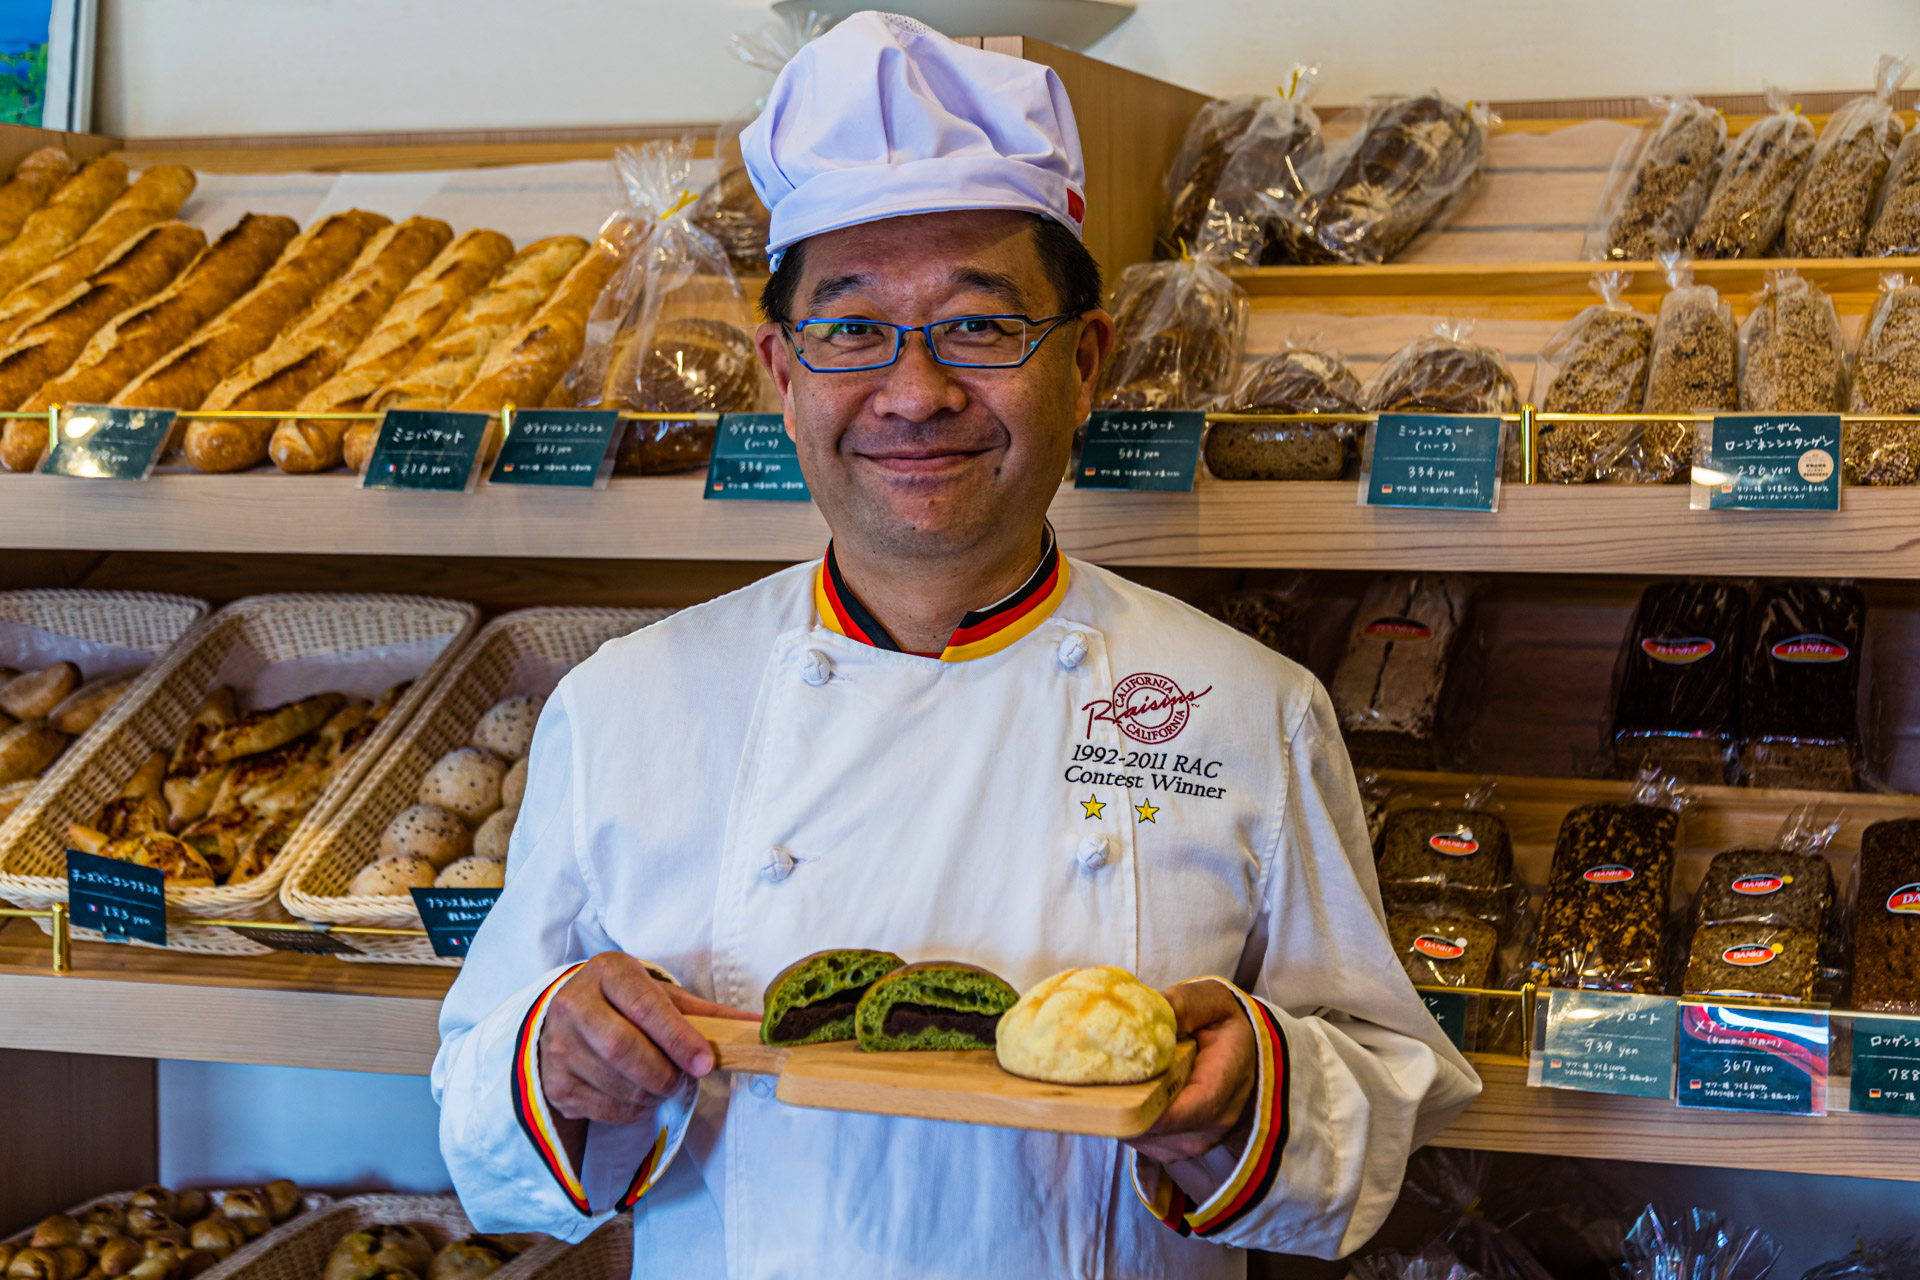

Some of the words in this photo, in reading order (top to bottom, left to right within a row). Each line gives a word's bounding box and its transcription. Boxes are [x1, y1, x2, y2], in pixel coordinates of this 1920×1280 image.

[1399, 424, 1474, 437] ミッシュブロート
[1753, 422, 1802, 435] ゼーザム
[1725, 435, 1835, 452] ロージネンシュタンゲン
[1143, 450, 1160, 460] yen
[1408, 466, 1434, 479] 334
[1437, 470, 1455, 480] yen
[1737, 464, 1766, 477] 286
[1771, 465, 1791, 479] yen
[1787, 643, 1833, 654] DANKE
[1115, 676, 1174, 708] CALIFORNIA
[1081, 685, 1213, 740] Raisins
[1126, 709, 1185, 740] CALIFORNIA
[1071, 744, 1168, 770] 1992-2011
[1172, 754, 1223, 778] RAC
[1064, 765, 1144, 788] Contest
[1150, 773, 1227, 799] Winner
[132, 915, 151, 926] yen
[1733, 950, 1766, 960] DANKE
[1584, 1038, 1613, 1054] 939
[1619, 1046, 1639, 1058] yen
[1723, 1058, 1751, 1075] 367
[1754, 1064, 1774, 1075] yen
[1888, 1067, 1920, 1081] 788
